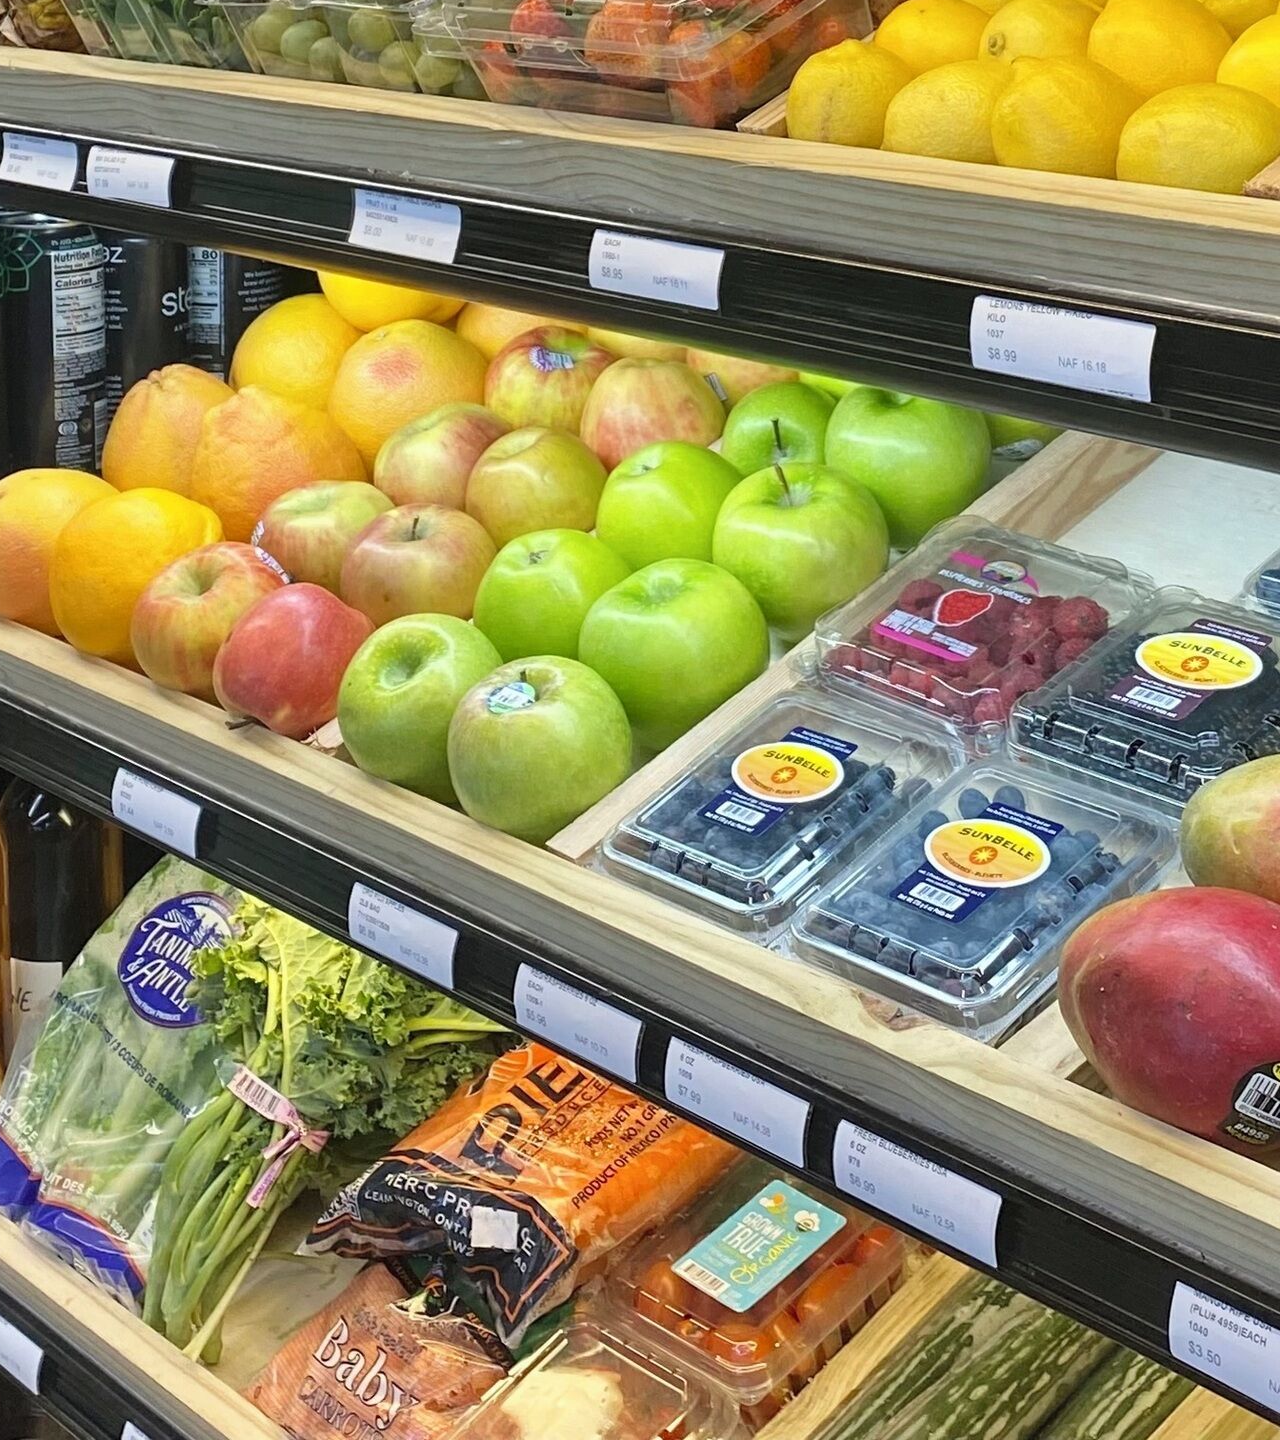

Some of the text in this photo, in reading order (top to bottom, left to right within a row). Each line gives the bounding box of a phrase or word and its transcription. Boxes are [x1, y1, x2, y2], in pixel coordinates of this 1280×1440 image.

[54, 248, 91, 263] Nutrition
[202, 250, 218, 260] 80
[55, 277, 93, 288] Calories
[652, 275, 669, 287] NAF
[987, 313, 1006, 323] KILO
[986, 328, 1004, 339] 1037
[987, 347, 1107, 373] $8.99 NAF 16.18
[117, 1046, 158, 1088] COEURS DE
[856, 1144, 867, 1156] OZ
[931, 1162, 949, 1178] USA
[571, 1153, 631, 1209] PRODUCT OF
[742, 1211, 786, 1240] GROWN
[722, 1222, 772, 1260] TRUE
[1189, 1302, 1217, 1321] (PLU#
[1188, 1320, 1209, 1337] 1040
[1187, 1340, 1223, 1367] $3.50
[312, 1314, 421, 1431] Baby
